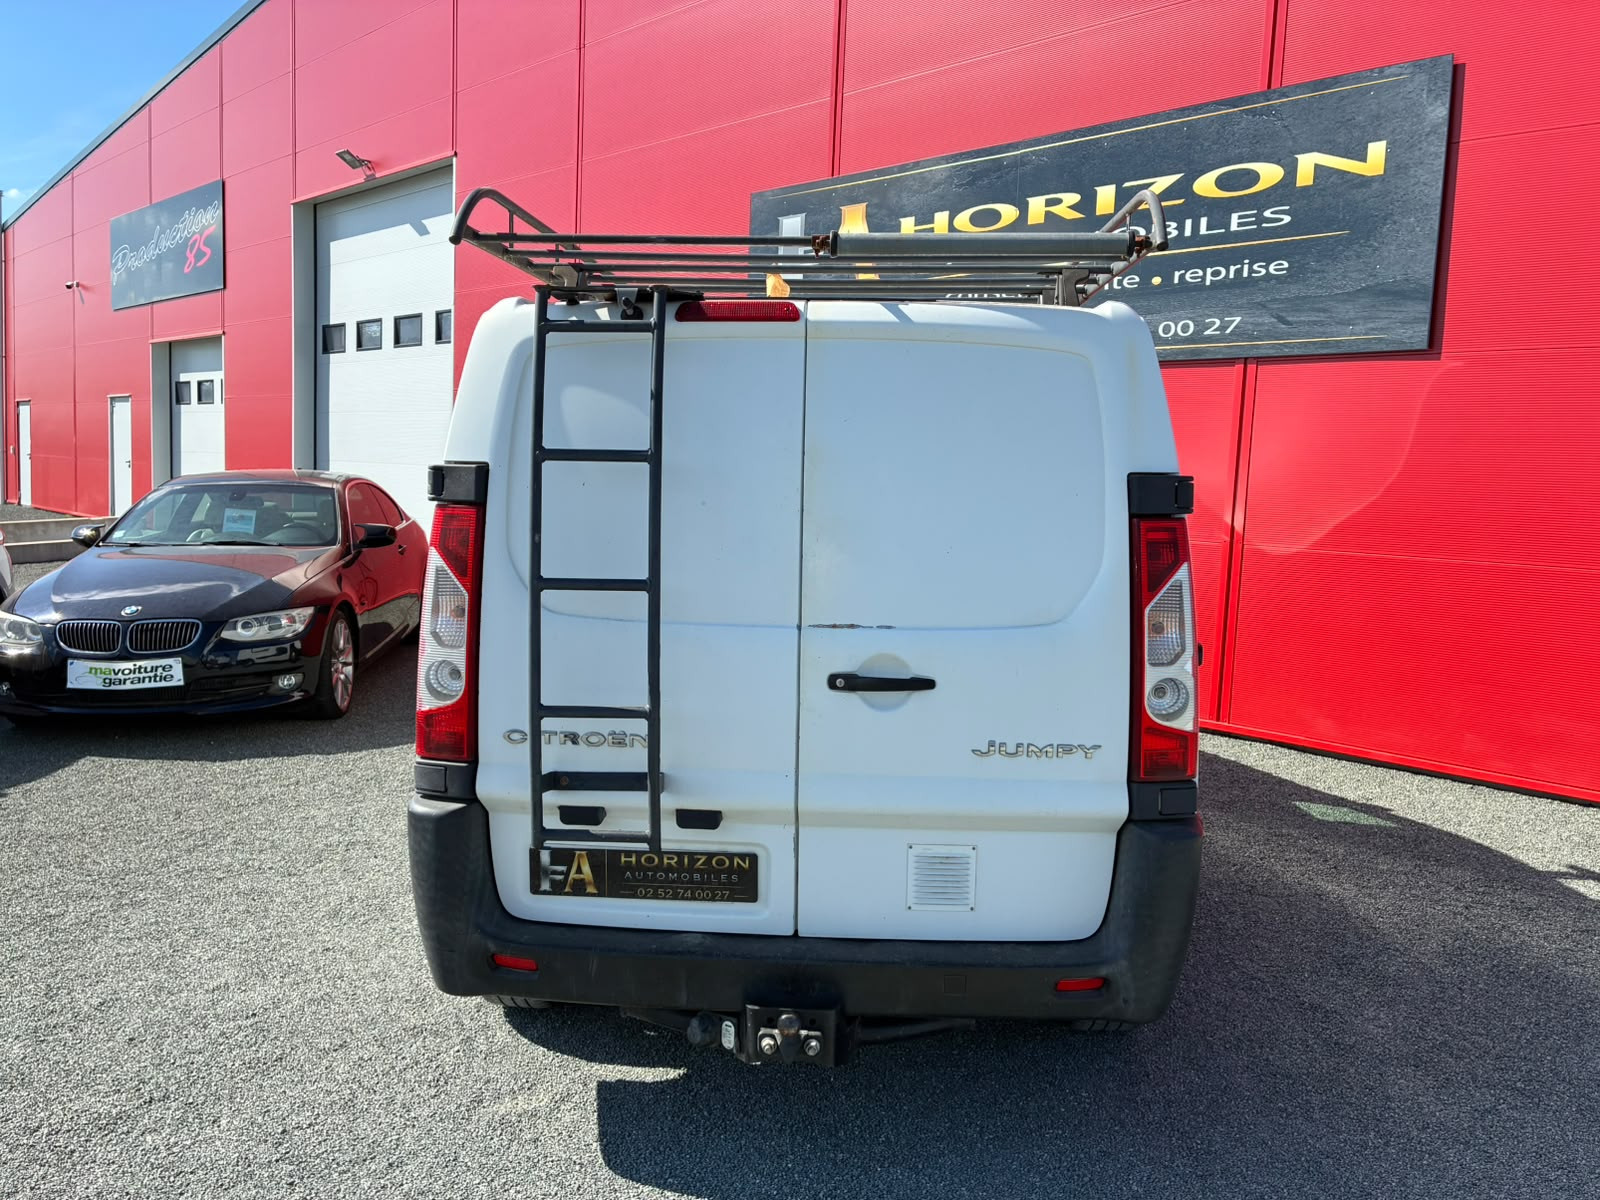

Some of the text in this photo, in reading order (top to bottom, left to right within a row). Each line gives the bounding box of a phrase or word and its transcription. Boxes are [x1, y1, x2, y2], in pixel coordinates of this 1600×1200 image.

[899, 140, 1387, 233] HORIZON
[112, 200, 219, 286] Production
[184, 224, 216, 274] 85
[1174, 259, 1289, 285] reprise
[1158, 317, 1242, 337] 00 27
[102, 673, 174, 687] garantie
[503, 729, 649, 748] CTROËN
[971, 740, 1102, 759] JUMPY
[620, 853, 750, 870] HORIZON
[624, 871, 739, 882] AUTOMOBILES
[637, 888, 730, 900] 02 52 74 00 27
